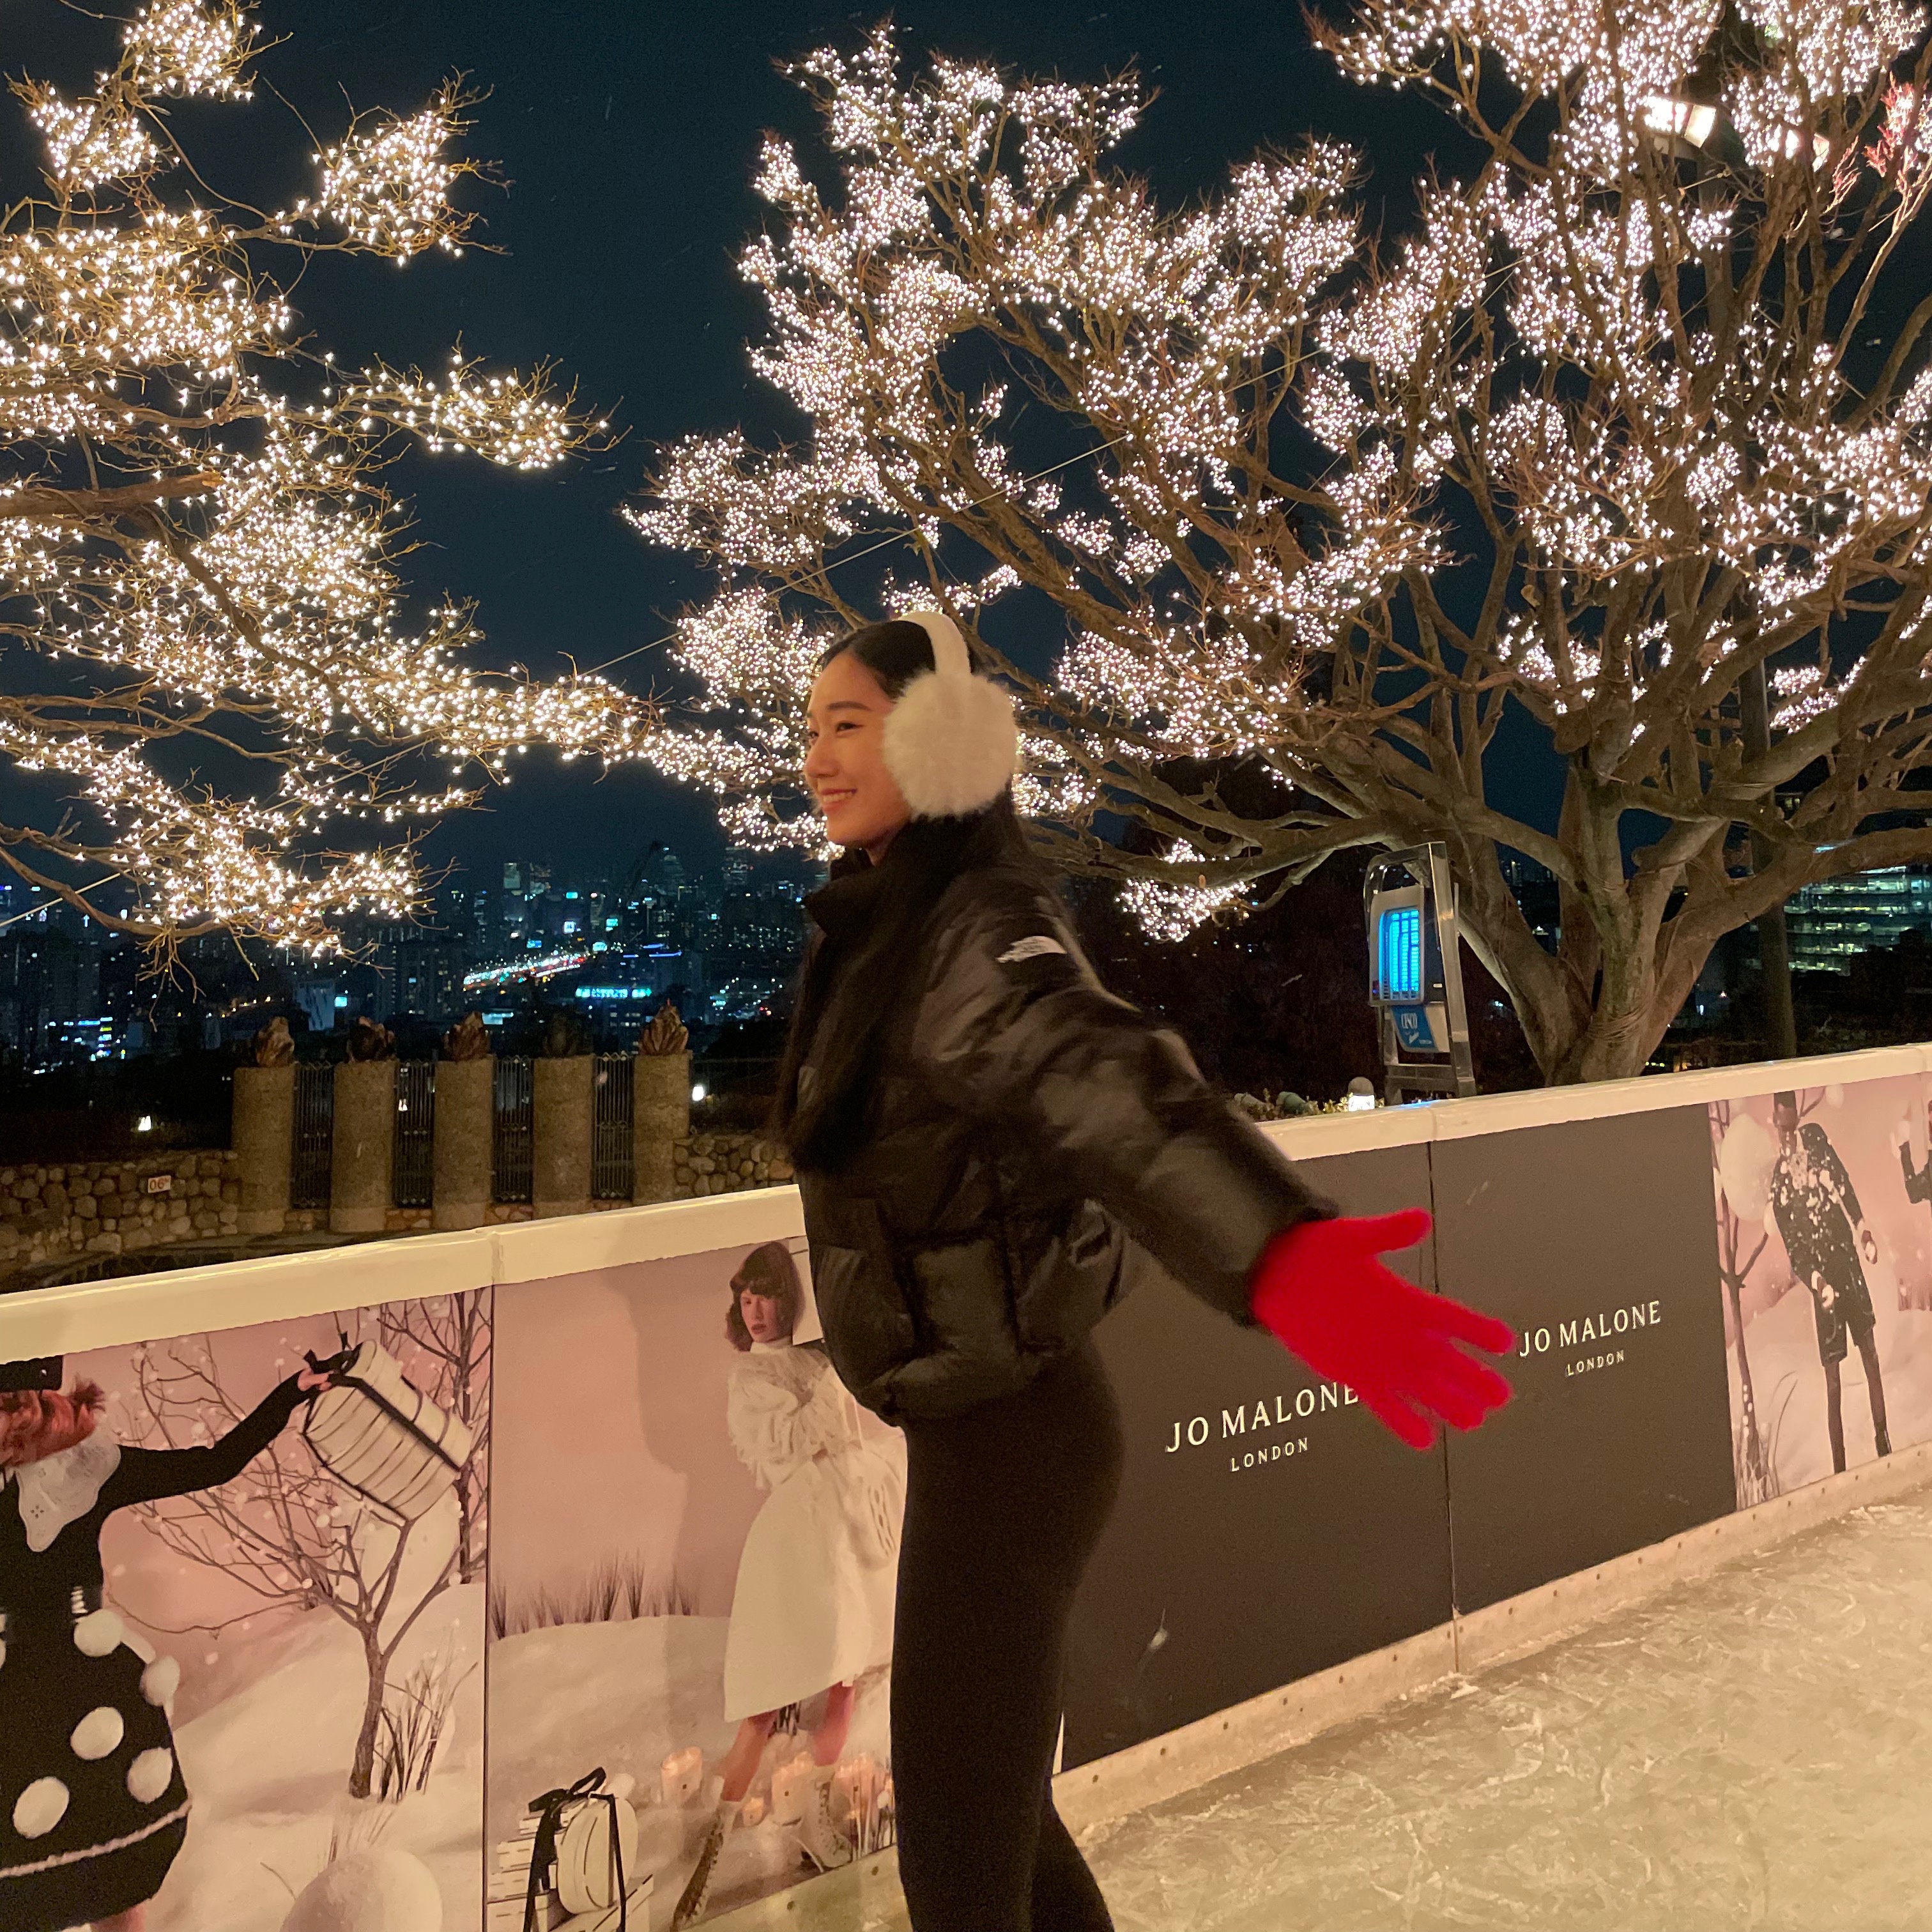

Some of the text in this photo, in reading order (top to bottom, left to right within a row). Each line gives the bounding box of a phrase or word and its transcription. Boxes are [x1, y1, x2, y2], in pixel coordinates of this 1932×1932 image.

[1519, 1301, 1661, 1358] JO MALONE
[1567, 1349, 1625, 1376] LONDON
[1165, 1382, 1359, 1453] JO MALONE
[1230, 1438, 1308, 1472] LONDON
